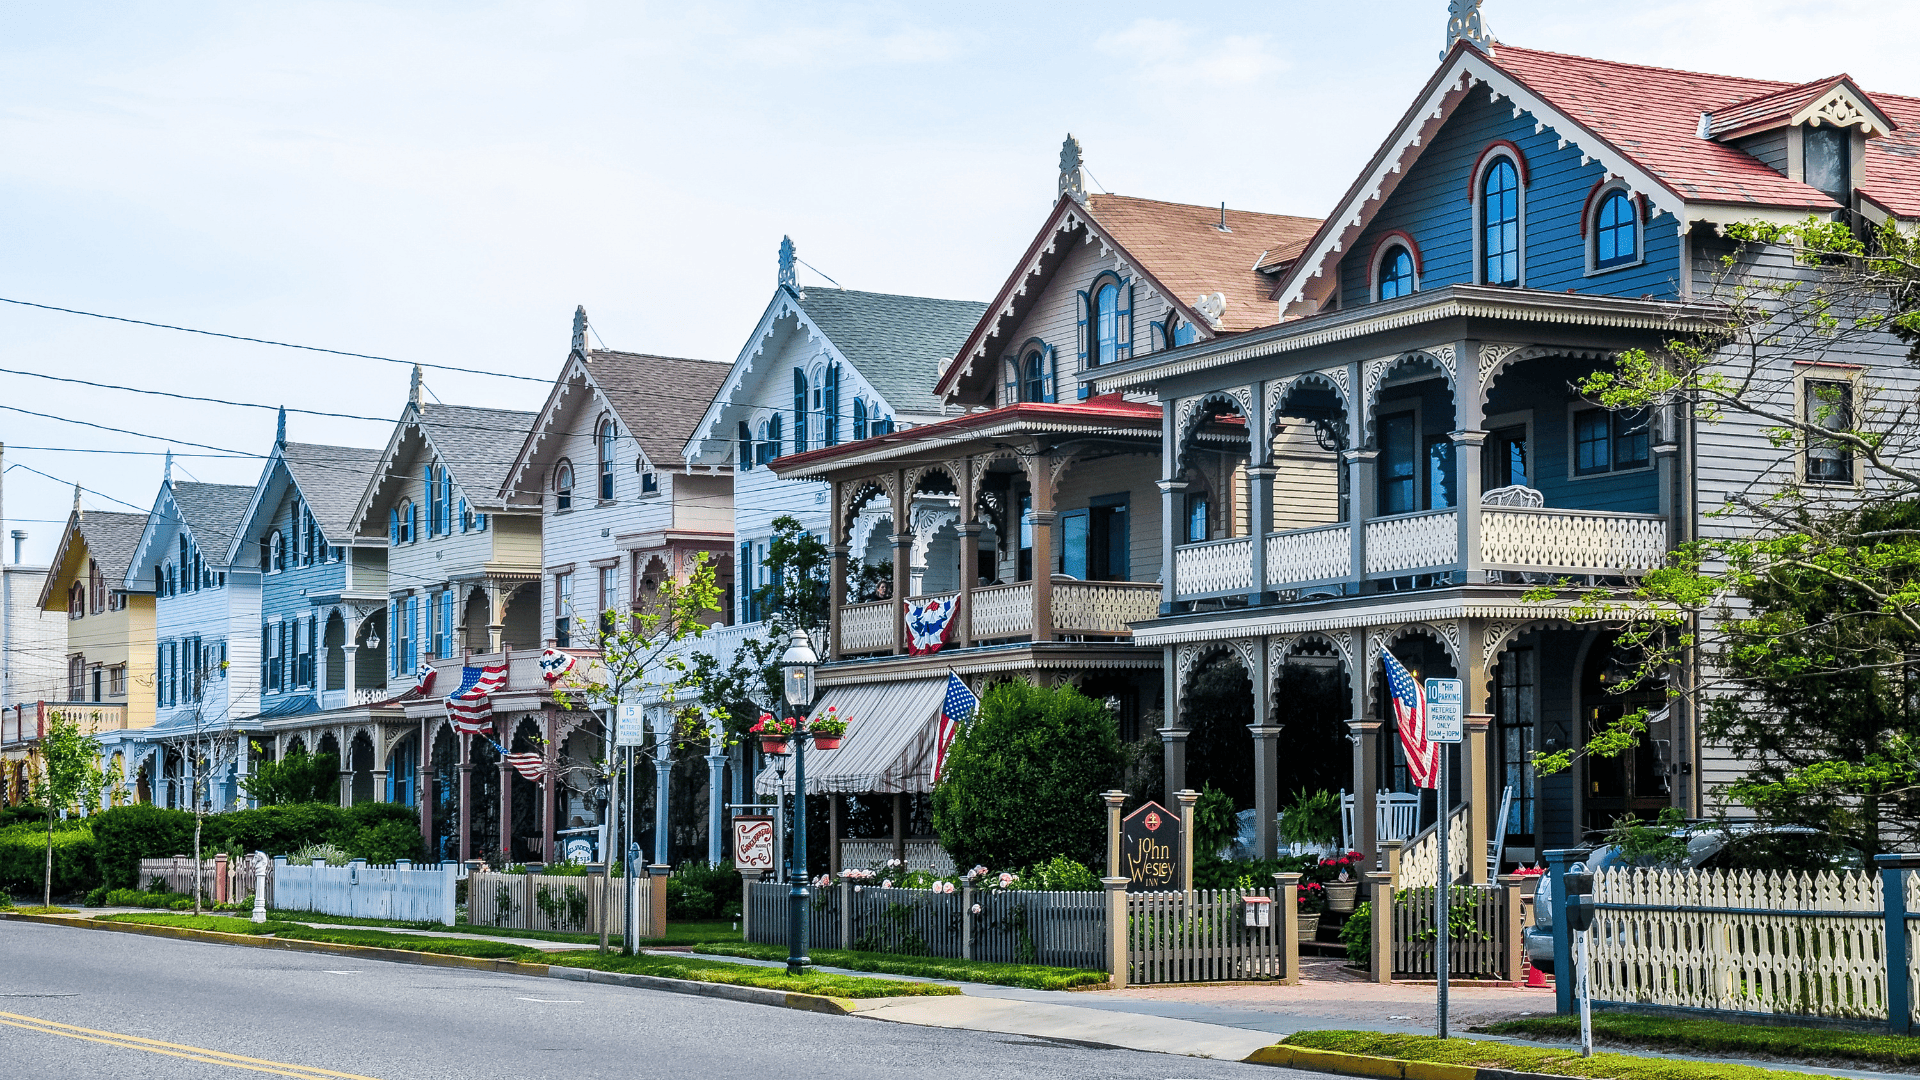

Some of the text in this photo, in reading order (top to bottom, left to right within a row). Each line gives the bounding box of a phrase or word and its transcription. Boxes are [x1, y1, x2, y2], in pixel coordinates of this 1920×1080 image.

[1444, 683, 1454, 691] HR
[1427, 685, 1438, 700] 10
[1438, 693, 1460, 702] PARKING
[625, 706, 635, 717] 15
[1430, 706, 1457, 714] METERED
[1145, 878, 1158, 887] INN
